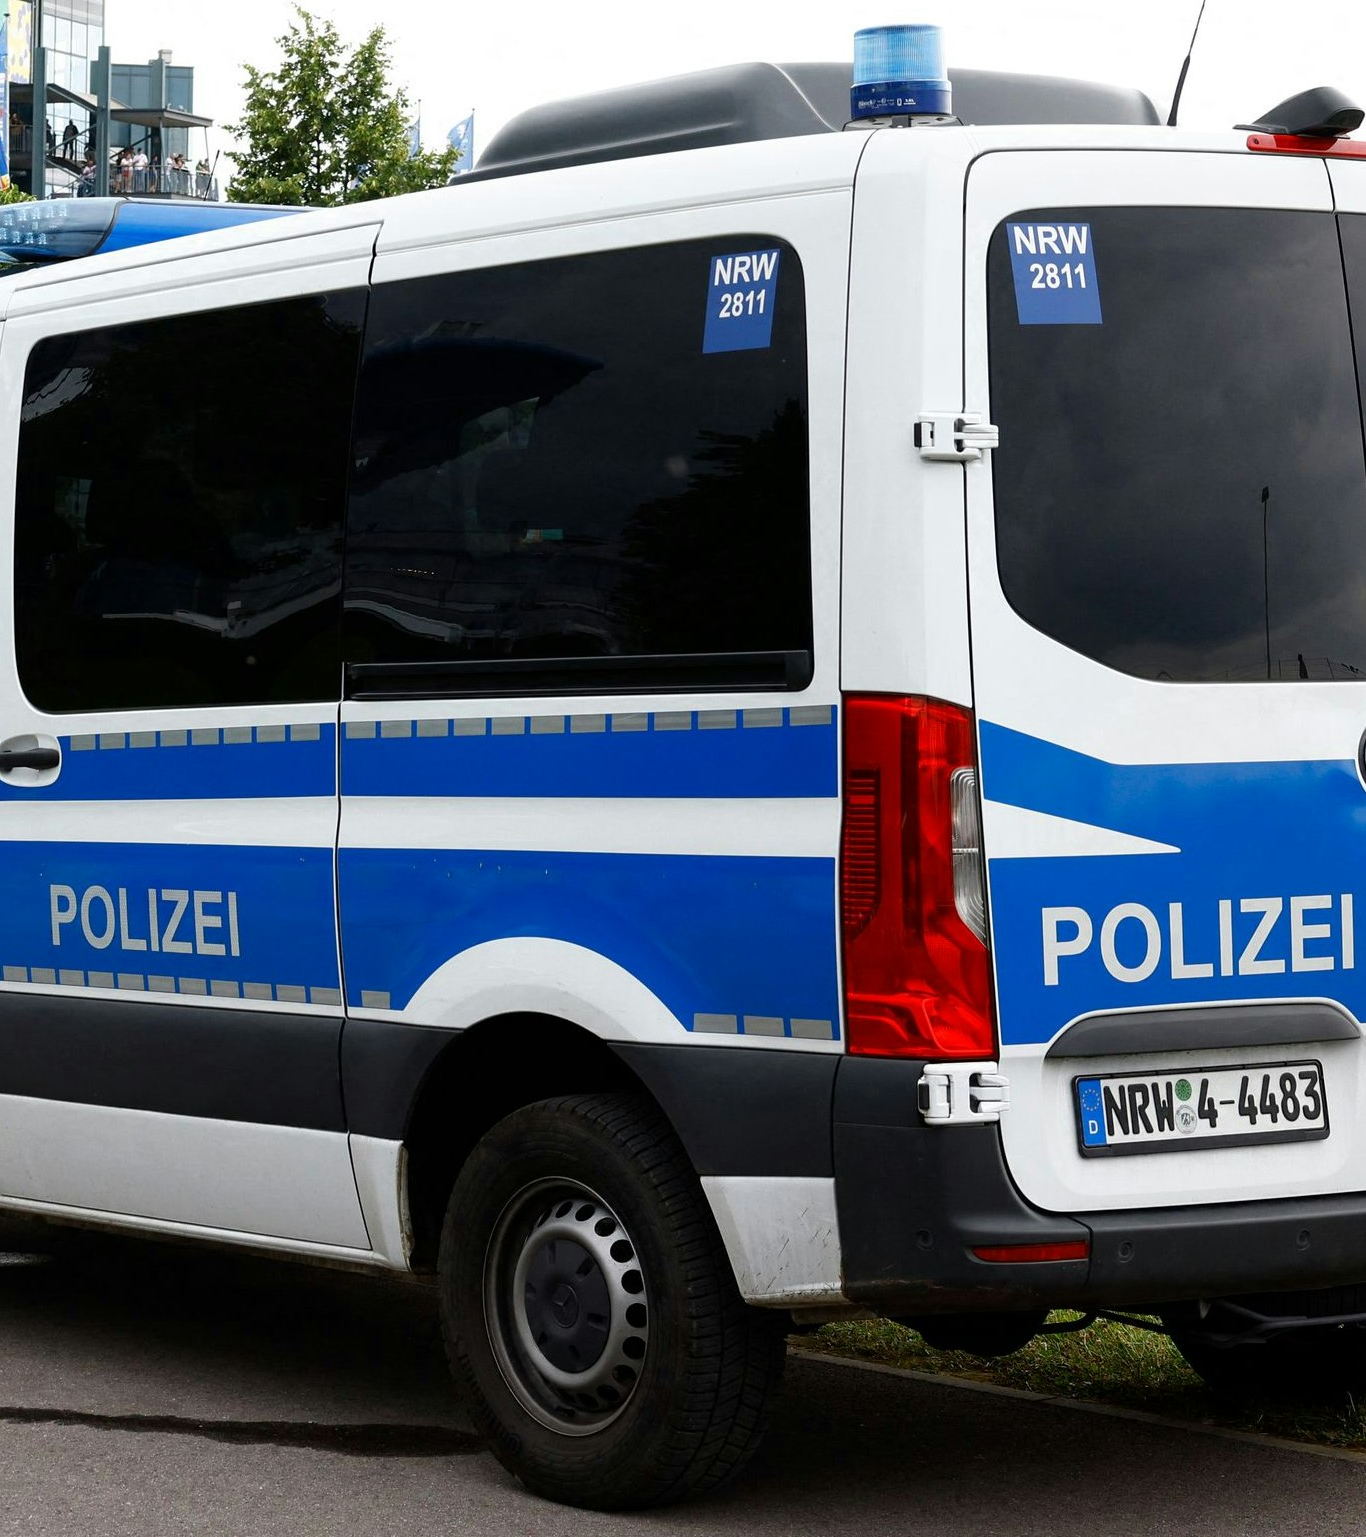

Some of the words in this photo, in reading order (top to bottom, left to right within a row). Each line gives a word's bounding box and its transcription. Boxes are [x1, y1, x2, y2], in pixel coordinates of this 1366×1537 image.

[1013, 225, 1088, 255] NRW
[713, 252, 778, 287] NRW
[1030, 263, 1087, 290] 2811
[718, 289, 766, 319] 2811
[50, 884, 240, 957] POLIZEI
[1041, 893, 1355, 986] POLIZEI
[1088, 1120, 1099, 1135] D
[1103, 1081, 1175, 1137] NRW
[1197, 1070, 1322, 1129] 4-4483
